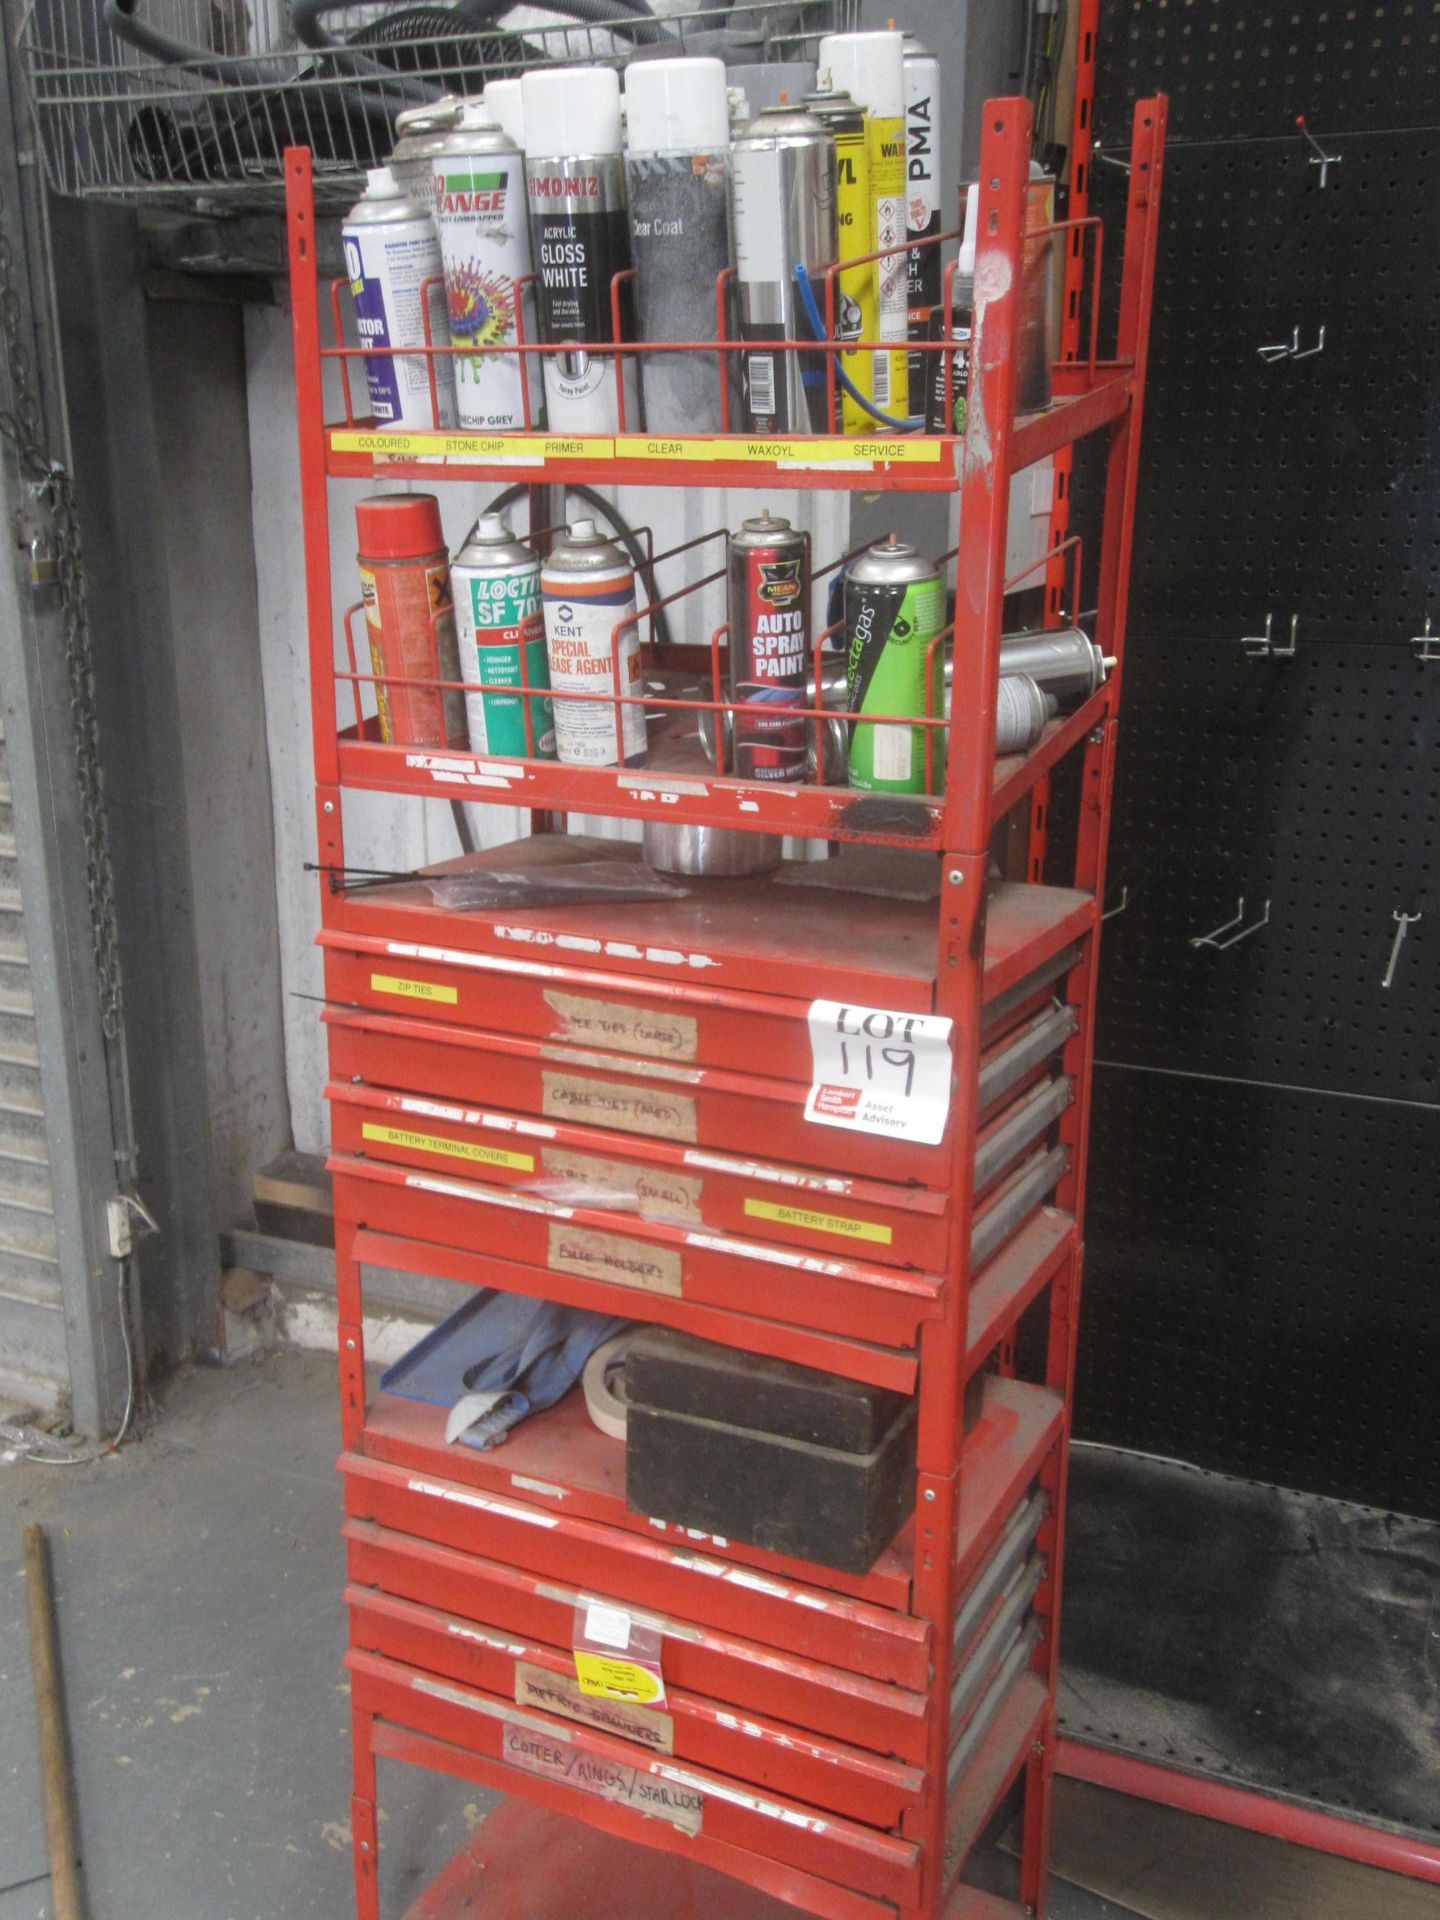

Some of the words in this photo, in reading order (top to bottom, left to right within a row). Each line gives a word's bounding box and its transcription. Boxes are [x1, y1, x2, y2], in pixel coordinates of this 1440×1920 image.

[908, 96, 931, 181] PMA
[837, 158, 857, 185] YL
[544, 226, 577, 239] ACRYLIC
[654, 218, 684, 236] Coat
[541, 243, 585, 264] GLOSS
[911, 247, 920, 260] &
[542, 267, 588, 288] WHITE
[487, 415, 513, 425] GREY
[358, 438, 411, 449] COLOURED
[445, 440, 478, 451] STONE
[480, 440, 504, 452] CHIP
[545, 442, 584, 453] PRIMER
[647, 443, 683, 455] CLEAR
[748, 444, 794, 457] WAXOYL
[853, 444, 904, 456] SERVICE
[767, 583, 795, 593] MEAN
[478, 600, 506, 625] SF
[757, 610, 802, 634] AUTO
[554, 625, 583, 637] KENT
[551, 638, 589, 657] SPECIAL
[752, 631, 805, 655] SPRAY
[576, 656, 612, 675] AGENT
[756, 653, 804, 677] PAINT
[397, 981, 411, 992] ZIP
[413, 983, 432, 996] TIES
[836, 1008, 925, 1044] LOT
[840, 1041, 915, 1097] 119
[820, 1093, 842, 1105] Smith
[822, 1087, 856, 1099] Lambert
[865, 1101, 894, 1113] Asset
[862, 1112, 908, 1128] Advisory
[388, 1130, 426, 1146] BATTERY
[429, 1139, 470, 1155] TERMINAL
[472, 1148, 509, 1164] COVERS
[778, 1208, 825, 1226] BATTERY
[826, 1219, 862, 1233] STRAP
